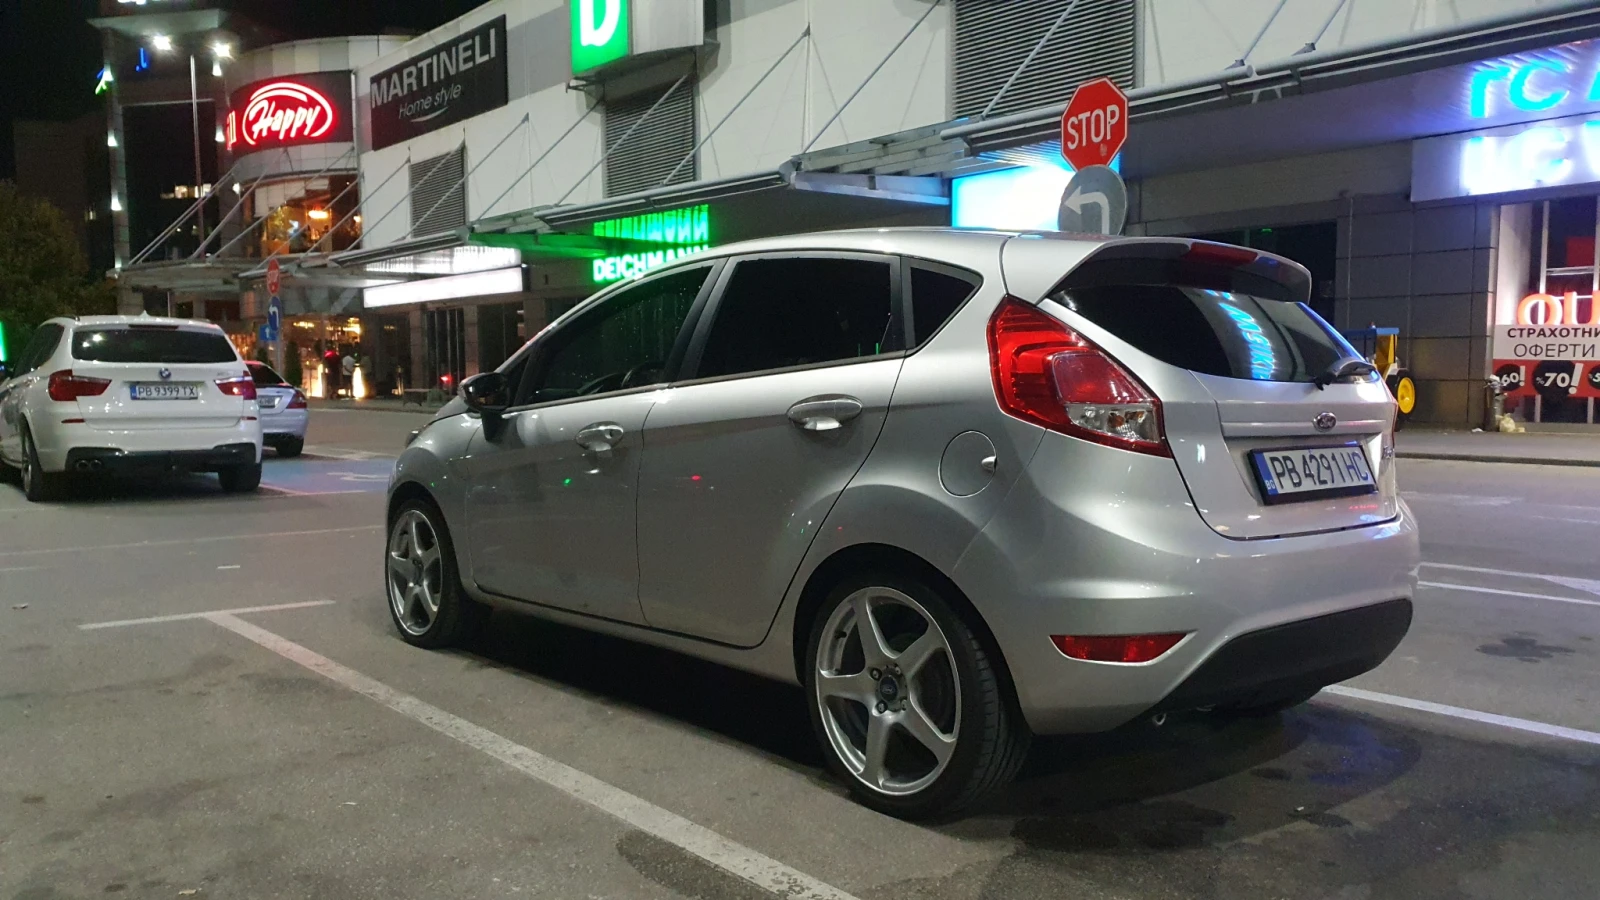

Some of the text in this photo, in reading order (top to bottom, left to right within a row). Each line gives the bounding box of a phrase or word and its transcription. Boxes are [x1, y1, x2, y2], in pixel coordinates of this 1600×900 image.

[370, 27, 496, 109] MARTINELI
[248, 99, 321, 140] Happy
[399, 83, 462, 119] Home style
[1066, 104, 1120, 150] STOP
[592, 244, 709, 283] DEICHMA
[1513, 343, 1596, 358] ОФЕРТИ
[138, 386, 152, 397] PB
[154, 386, 180, 398] 9399
[182, 386, 196, 397] TX
[1268, 451, 1369, 490] PB 4291 HC
